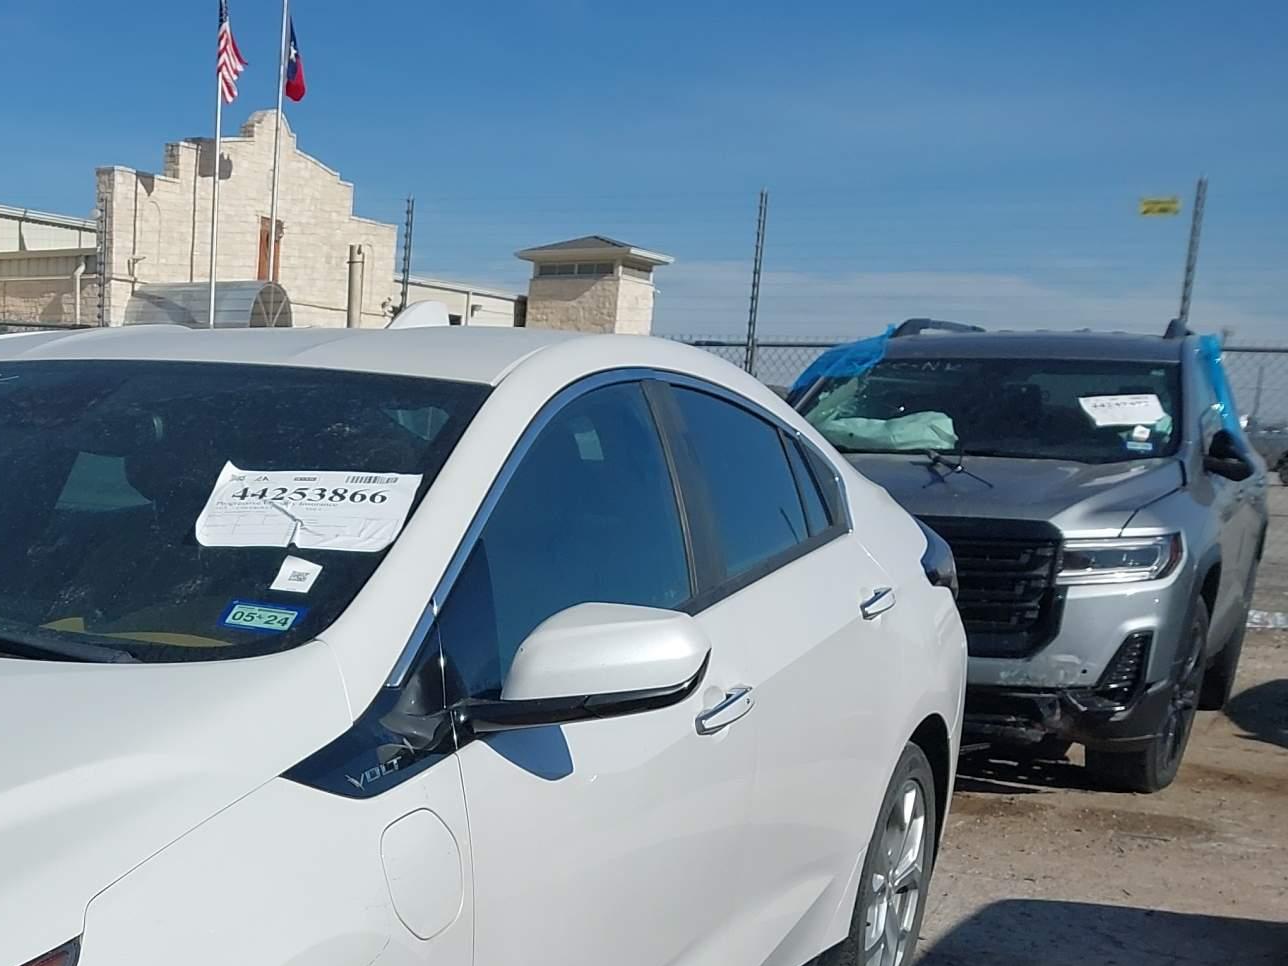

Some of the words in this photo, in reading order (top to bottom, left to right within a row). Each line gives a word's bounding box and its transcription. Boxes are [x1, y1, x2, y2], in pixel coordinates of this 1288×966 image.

[231, 486, 388, 504] 44253866
[232, 610, 258, 622] 05
[263, 614, 290, 627] 24
[345, 755, 402, 791] VOLT
